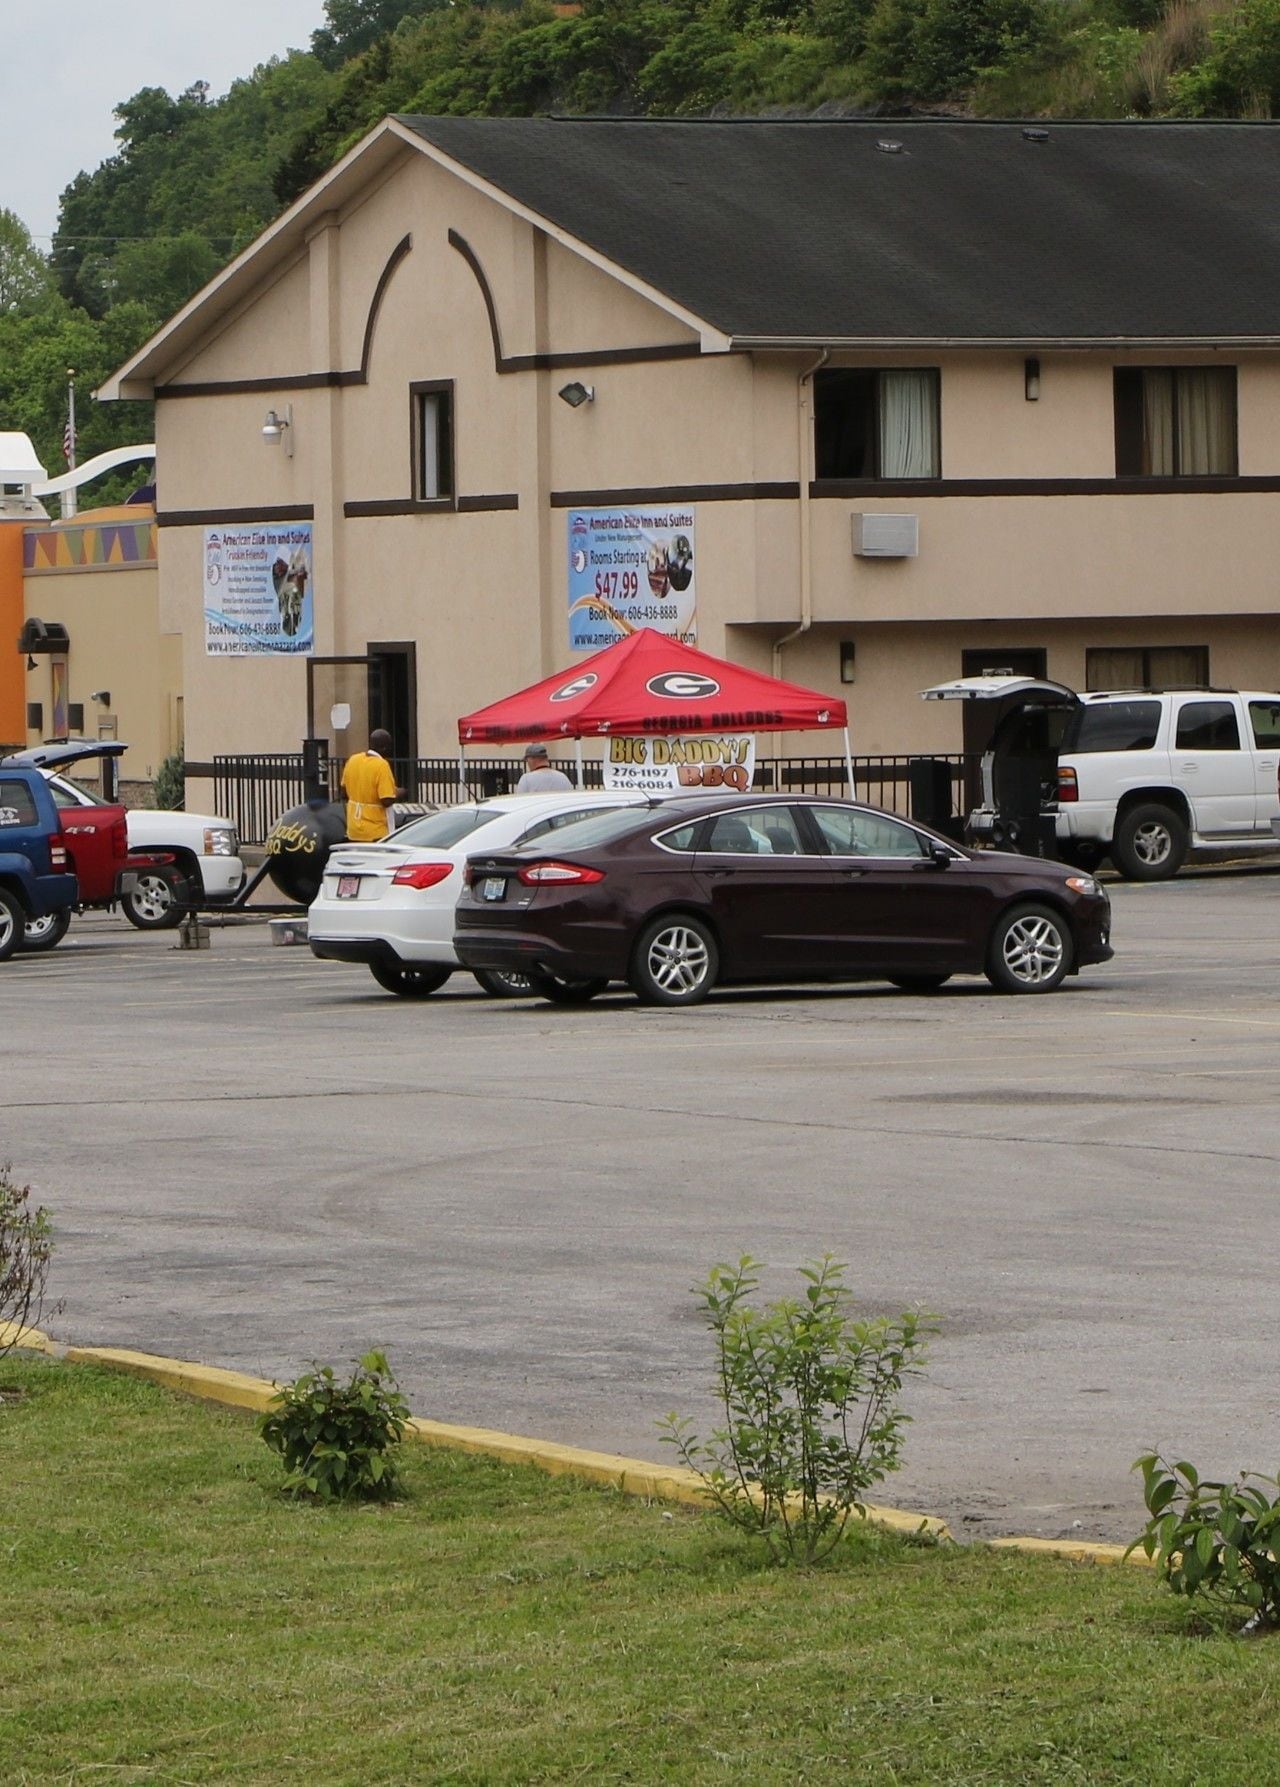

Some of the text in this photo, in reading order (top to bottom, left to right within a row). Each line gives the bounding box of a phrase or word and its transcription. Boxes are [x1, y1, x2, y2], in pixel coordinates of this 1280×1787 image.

[590, 517, 623, 531] American
[640, 515, 653, 529] Inn
[654, 514, 668, 528] and
[668, 513, 693, 528] Suites
[278, 531, 290, 545] and
[590, 548, 647, 567] Rooms Starting at
[595, 570, 638, 600] $47.99
[589, 606, 607, 620] Book
[628, 605, 678, 620] 606-436-8888
[610, 735, 750, 766] BIG DADDY'S
[612, 767, 669, 777] 276-1197
[677, 765, 750, 792] BBQ
